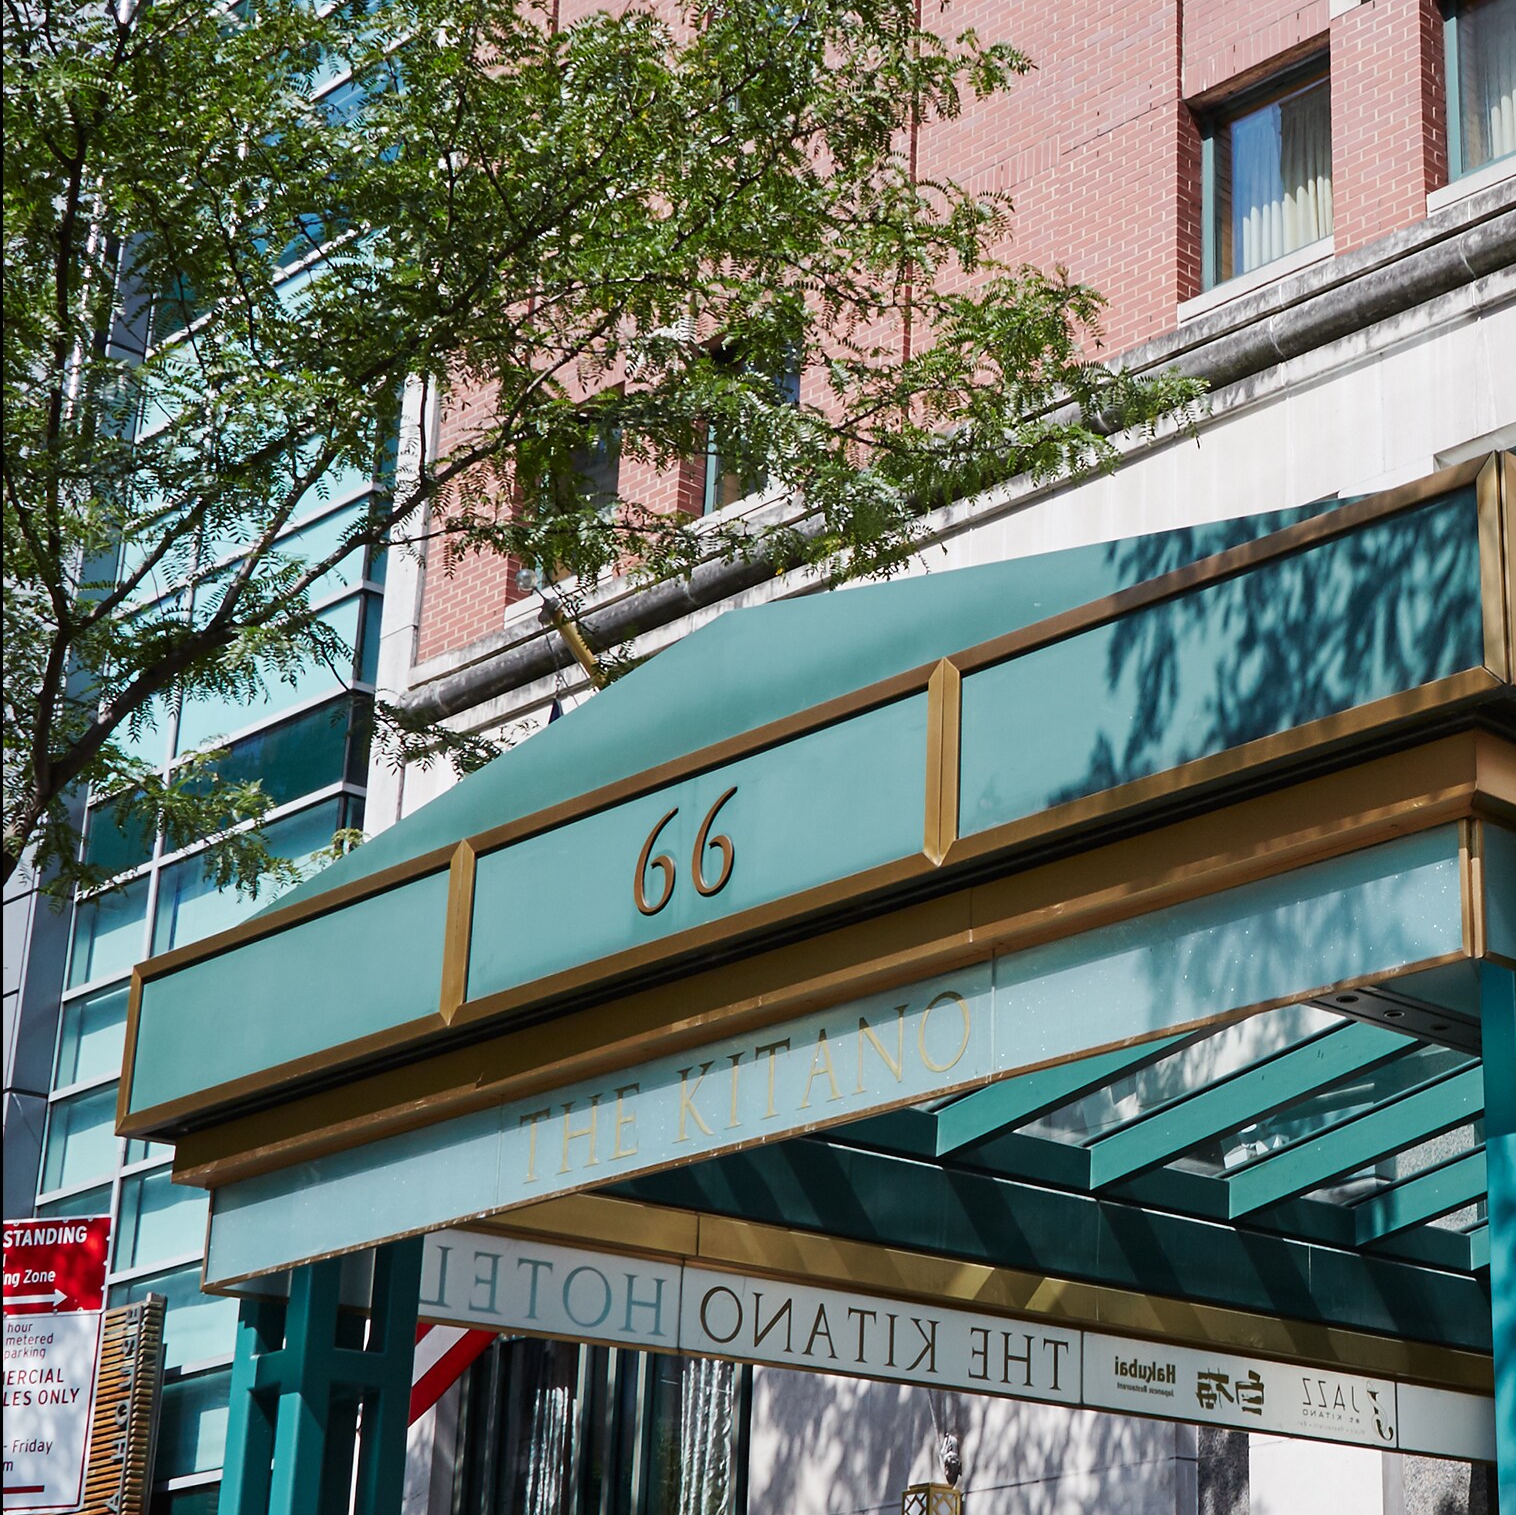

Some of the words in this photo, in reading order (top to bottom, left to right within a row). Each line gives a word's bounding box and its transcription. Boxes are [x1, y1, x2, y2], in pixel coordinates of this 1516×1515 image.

[633, 785, 738, 917] 66
[519, 1083, 641, 1184] THE
[672, 990, 971, 1145] KITANO
[3, 1225, 88, 1249] STANDING
[23, 1269, 56, 1284] Zone
[7, 1323, 33, 1334] hour
[6, 1333, 54, 1346] metered
[4, 1346, 46, 1360] parking
[3, 1368, 64, 1386] ERCIAL
[110, 1305, 142, 1464] HOUSE
[38, 1388, 80, 1406] ONLY
[12, 1439, 53, 1455] Friday
